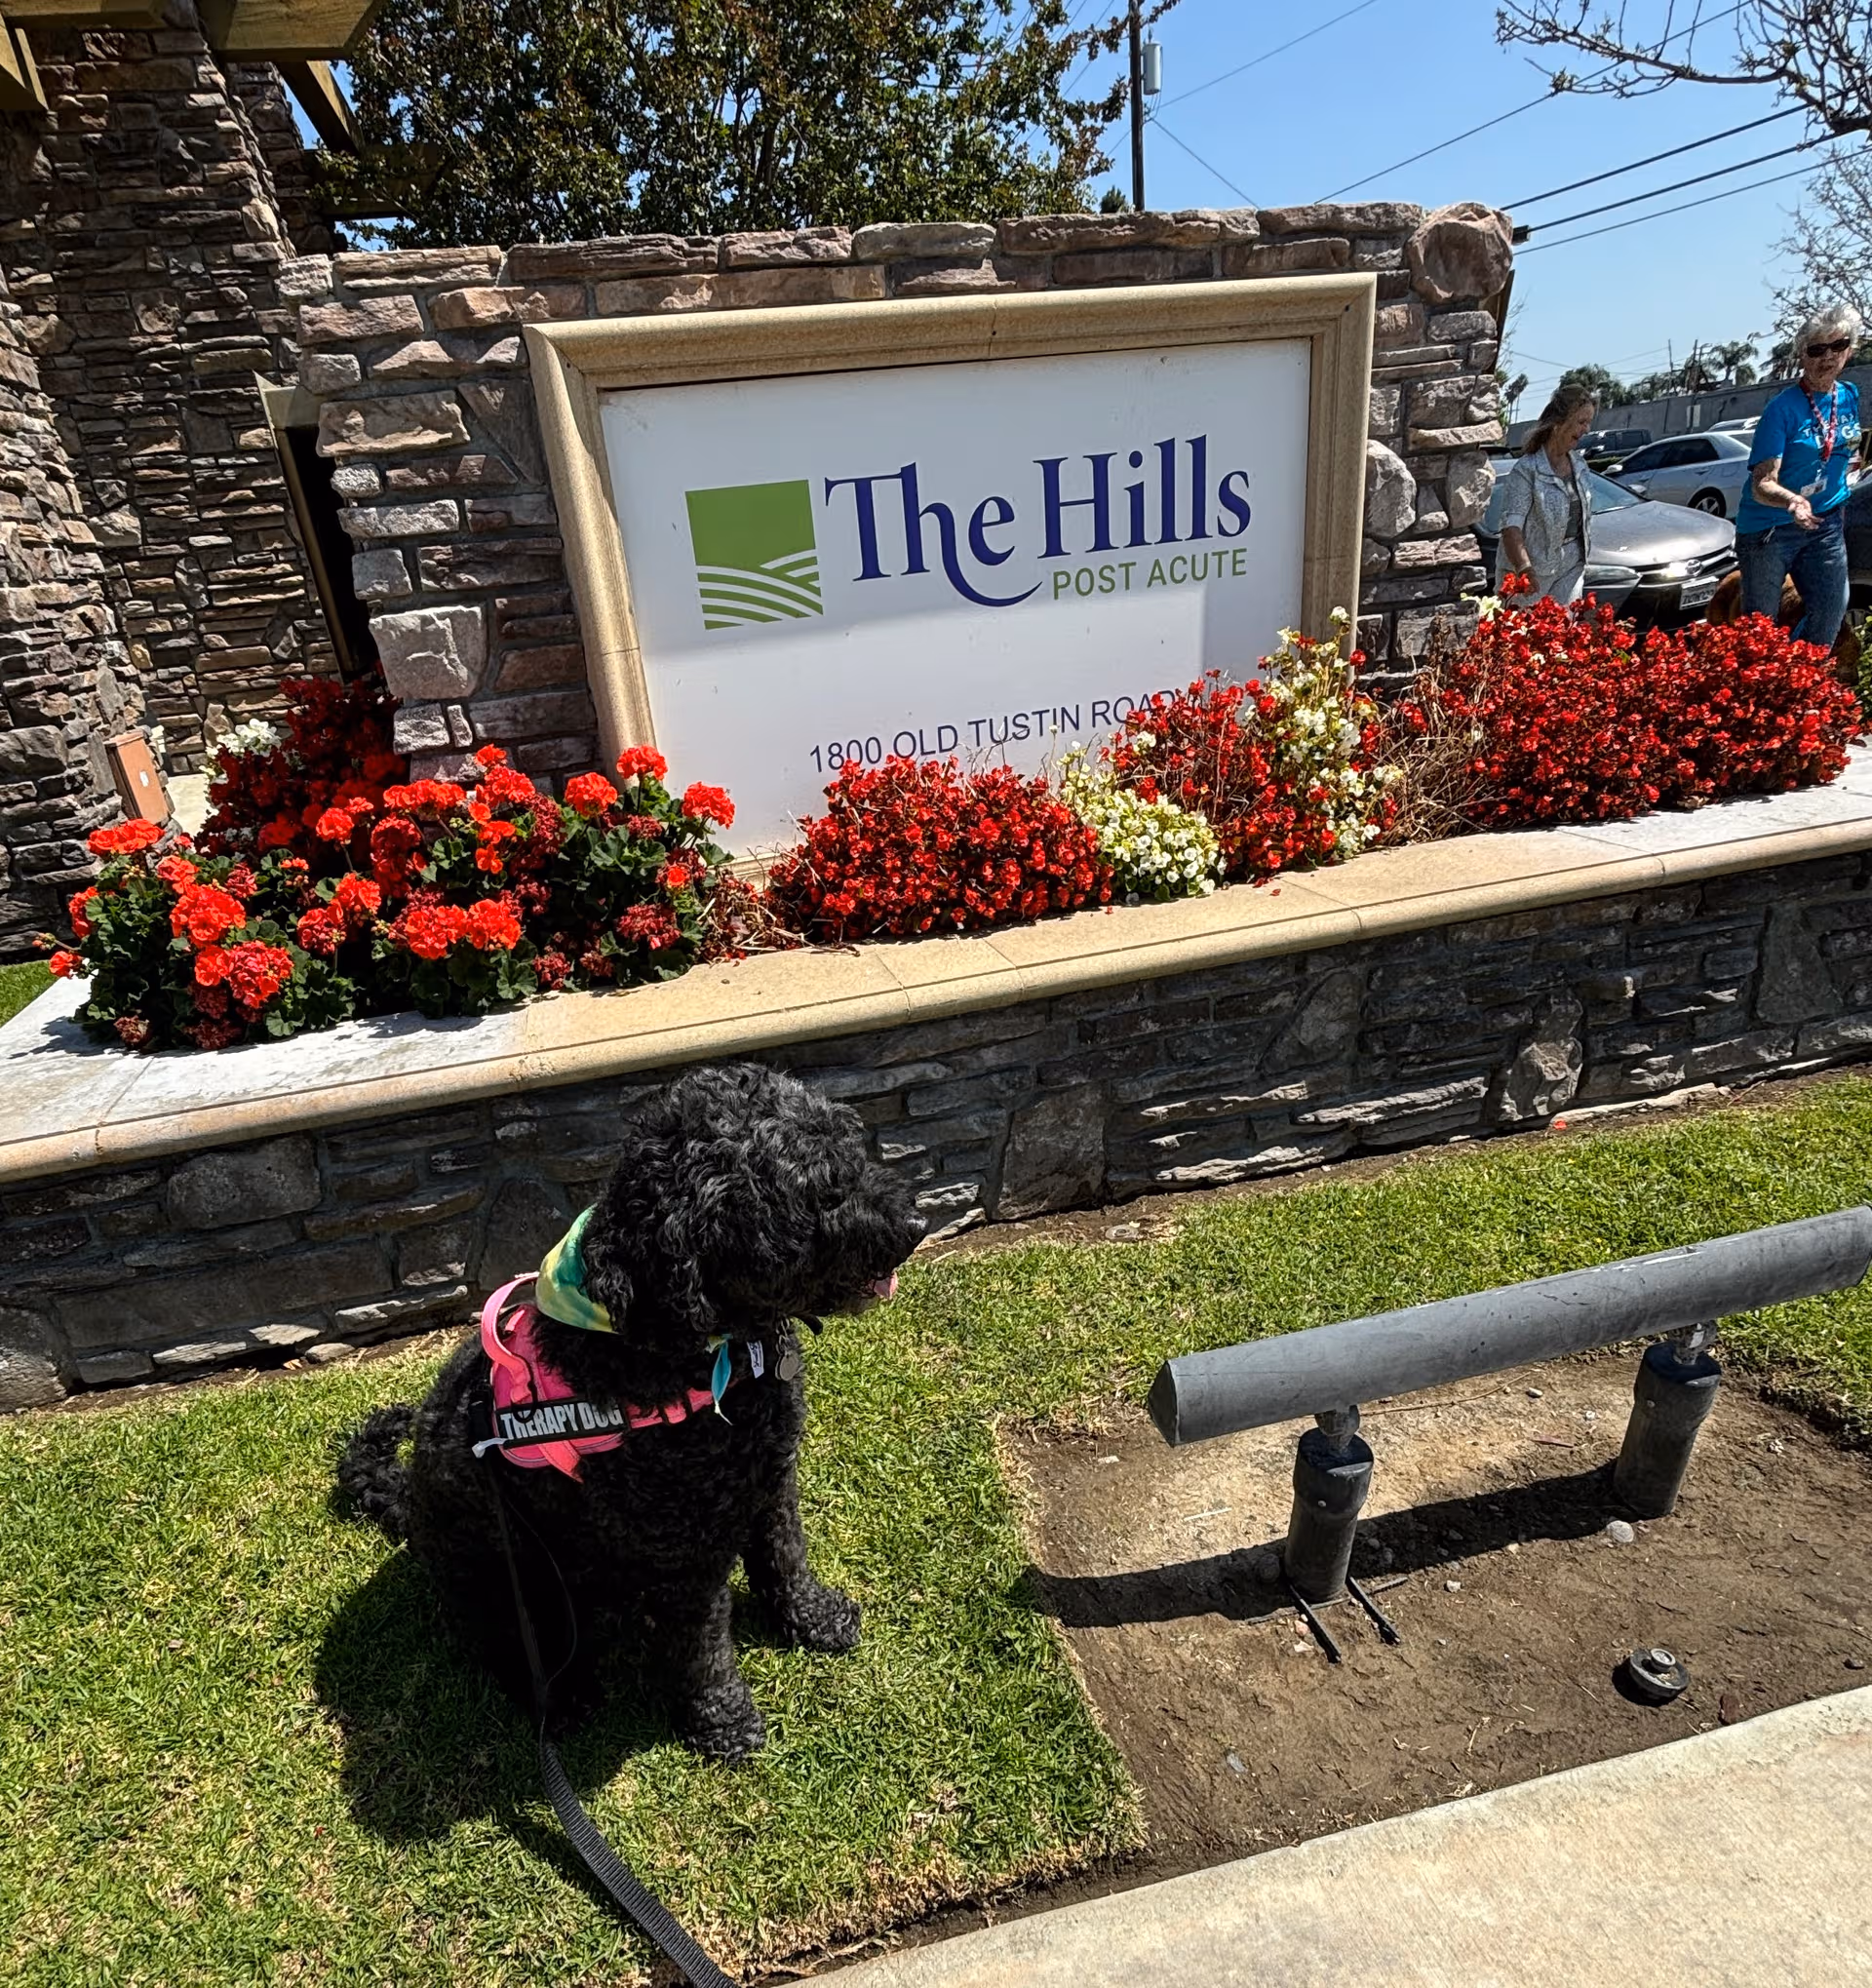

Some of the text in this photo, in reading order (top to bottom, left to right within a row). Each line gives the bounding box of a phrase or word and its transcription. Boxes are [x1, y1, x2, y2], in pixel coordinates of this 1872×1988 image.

[825, 434, 1251, 606] The Hills
[1053, 548, 1247, 600] POST ACUTE
[810, 737, 881, 773] 1800
[893, 724, 958, 759] OLD
[967, 704, 1079, 747] TUSTIN
[500, 1404, 578, 1440] THERAPY
